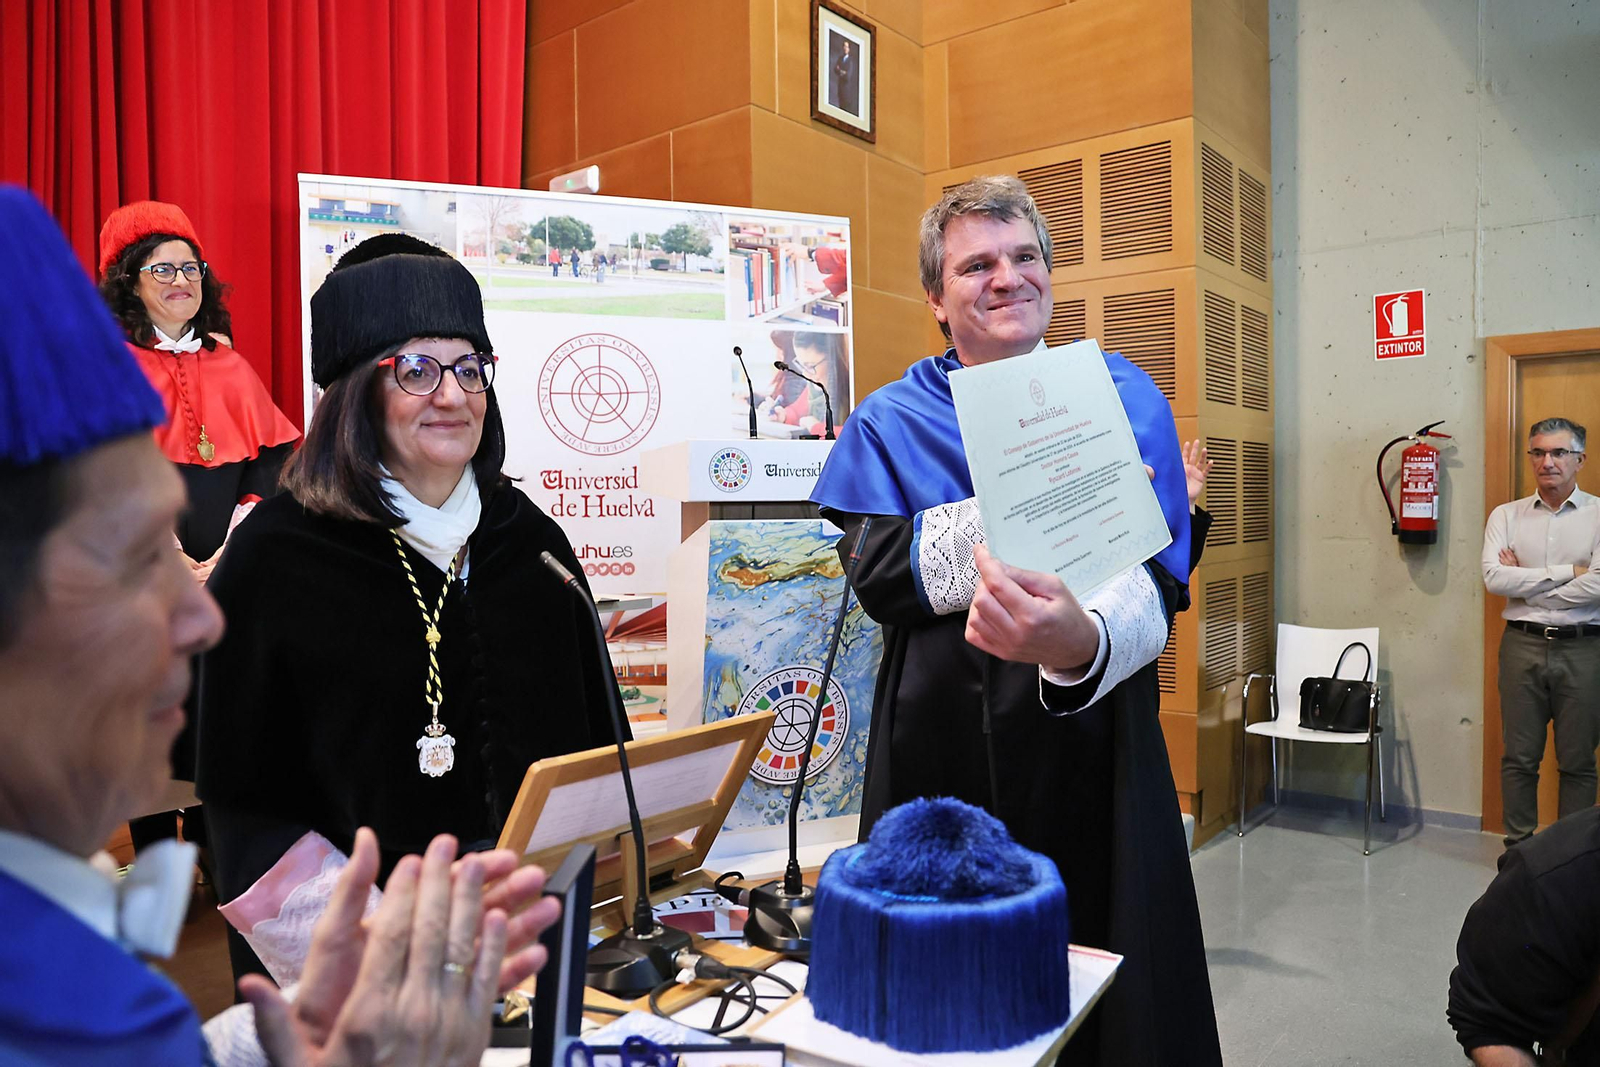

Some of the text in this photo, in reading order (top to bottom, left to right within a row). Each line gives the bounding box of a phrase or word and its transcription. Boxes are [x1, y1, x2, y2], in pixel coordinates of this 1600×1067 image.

[1378, 341, 1421, 355] EXTINTOR
[540, 466, 639, 490] Universid
[764, 462, 821, 477] Universid
[551, 493, 655, 518] de Huelva
[573, 544, 633, 558] uhu.es
[742, 670, 801, 714] ERSITAS
